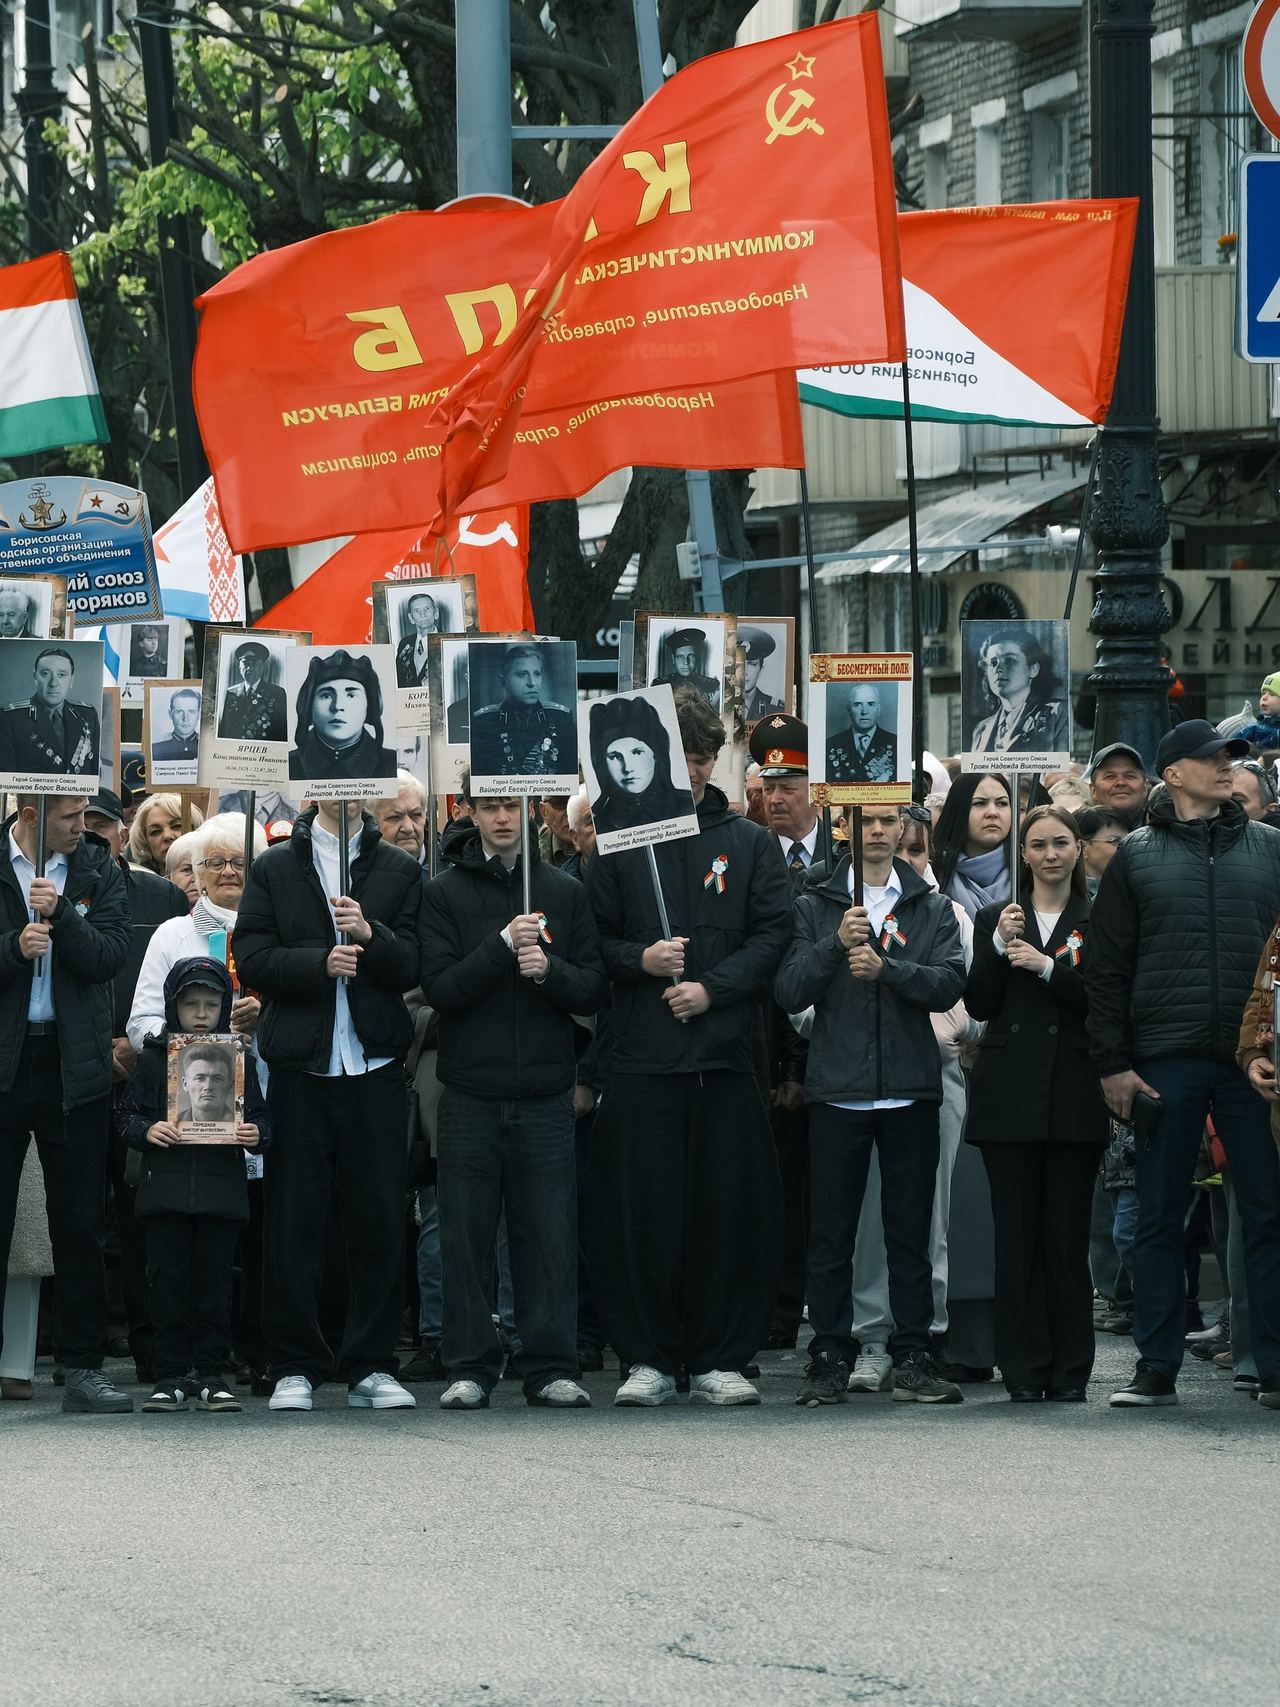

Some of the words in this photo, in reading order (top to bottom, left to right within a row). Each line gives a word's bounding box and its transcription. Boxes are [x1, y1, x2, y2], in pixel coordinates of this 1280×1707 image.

[10, 531, 82, 547] Борисовская
[42, 539, 114, 556] организация
[56, 547, 132, 563] объединения
[94, 570, 145, 589] союз
[837, 660, 889, 676] БЕССМЕРТНЫЙ
[890, 663, 910, 675] ПОЛК
[236, 744, 268, 754] ЯРЦЕВ
[212, 753, 257, 762] Константин
[30, 776, 58, 784] Советского
[33, 783, 54, 791] Борис
[55, 784, 95, 793] Васильевич
[304, 790, 333, 798] Данилов
[479, 786, 507, 794] Вайнруб
[528, 785, 571, 794] Григорьевич
[603, 840, 631, 851] Петряев
[631, 833, 664, 845] Александр
[665, 826, 695, 838] Акимович
[617, 832, 633, 840] Герой
[633, 826, 661, 837] Советского
[661, 822, 678, 831] Союза
